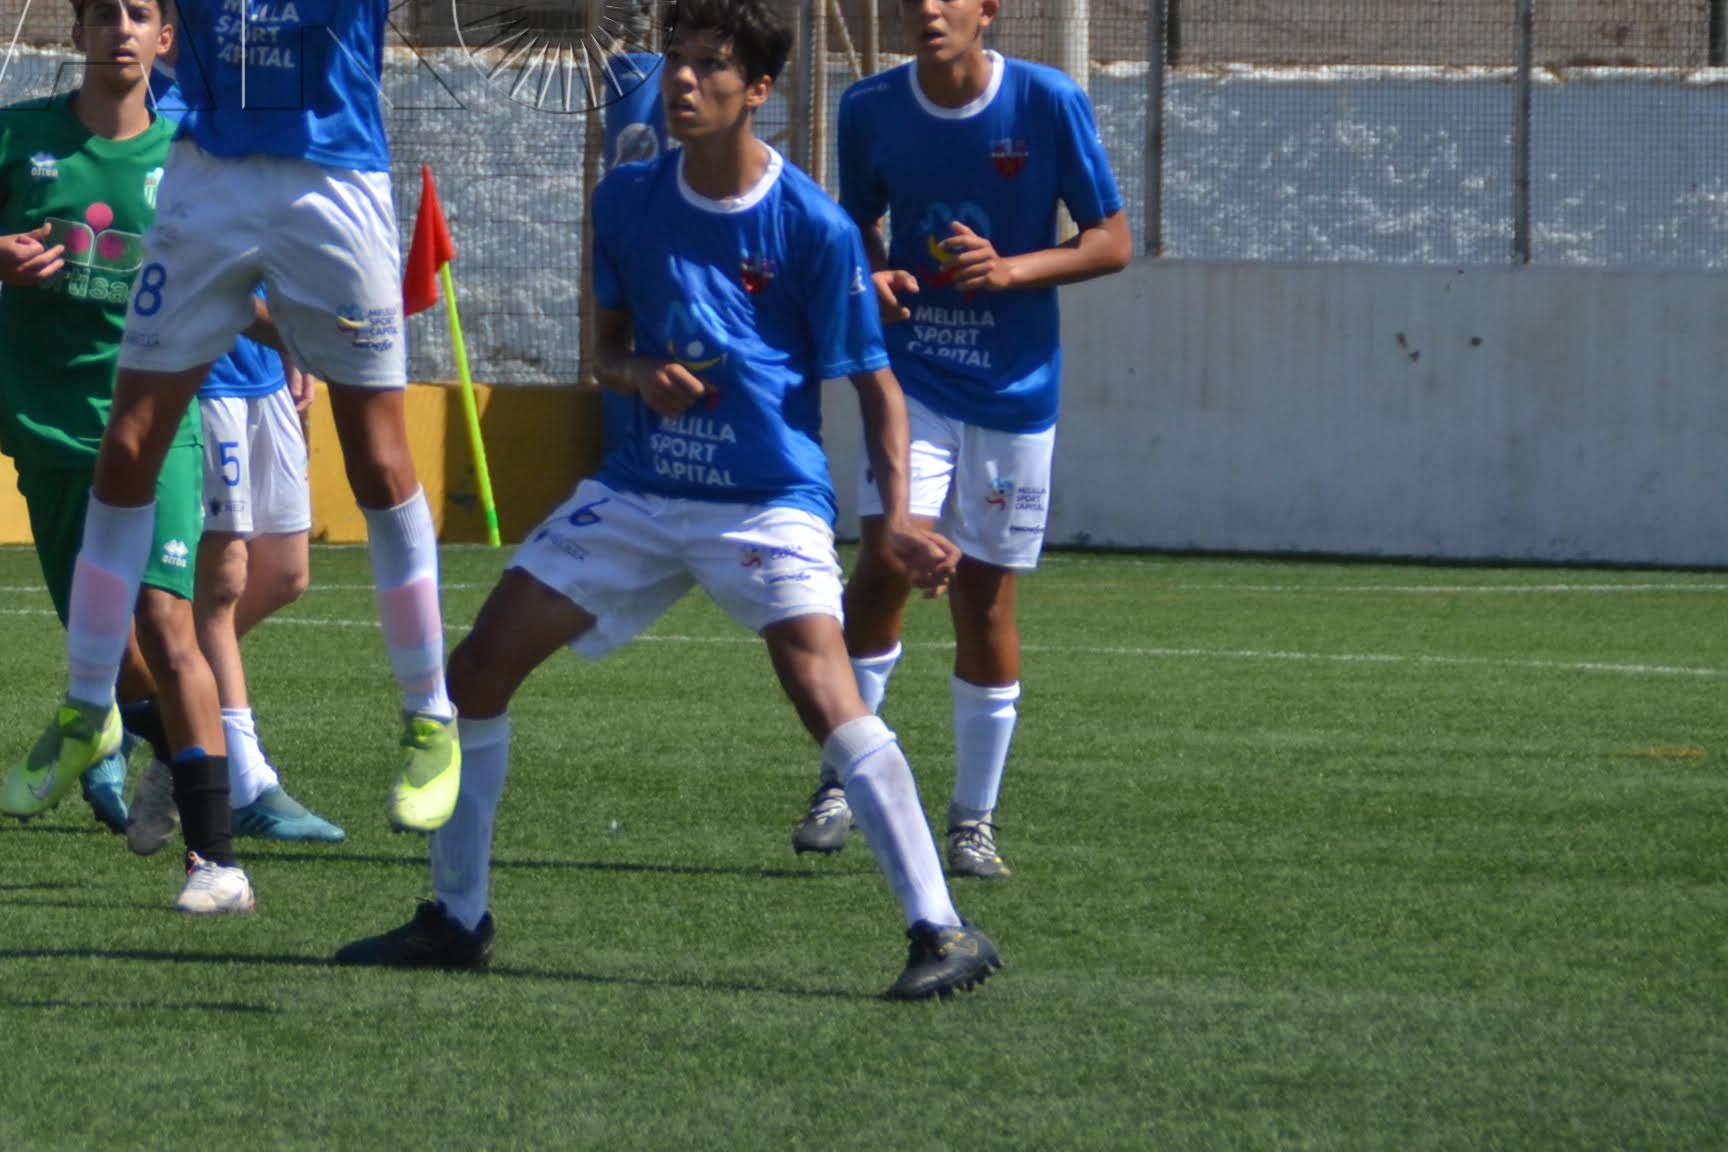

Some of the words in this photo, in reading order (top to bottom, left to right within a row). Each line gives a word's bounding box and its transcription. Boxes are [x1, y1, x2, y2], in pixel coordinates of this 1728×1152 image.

[134, 262, 167, 317] 8
[914, 305, 995, 328] MELILLA
[912, 325, 980, 346] SPORT
[219, 441, 240, 487] 5
[567, 497, 610, 527] 6
